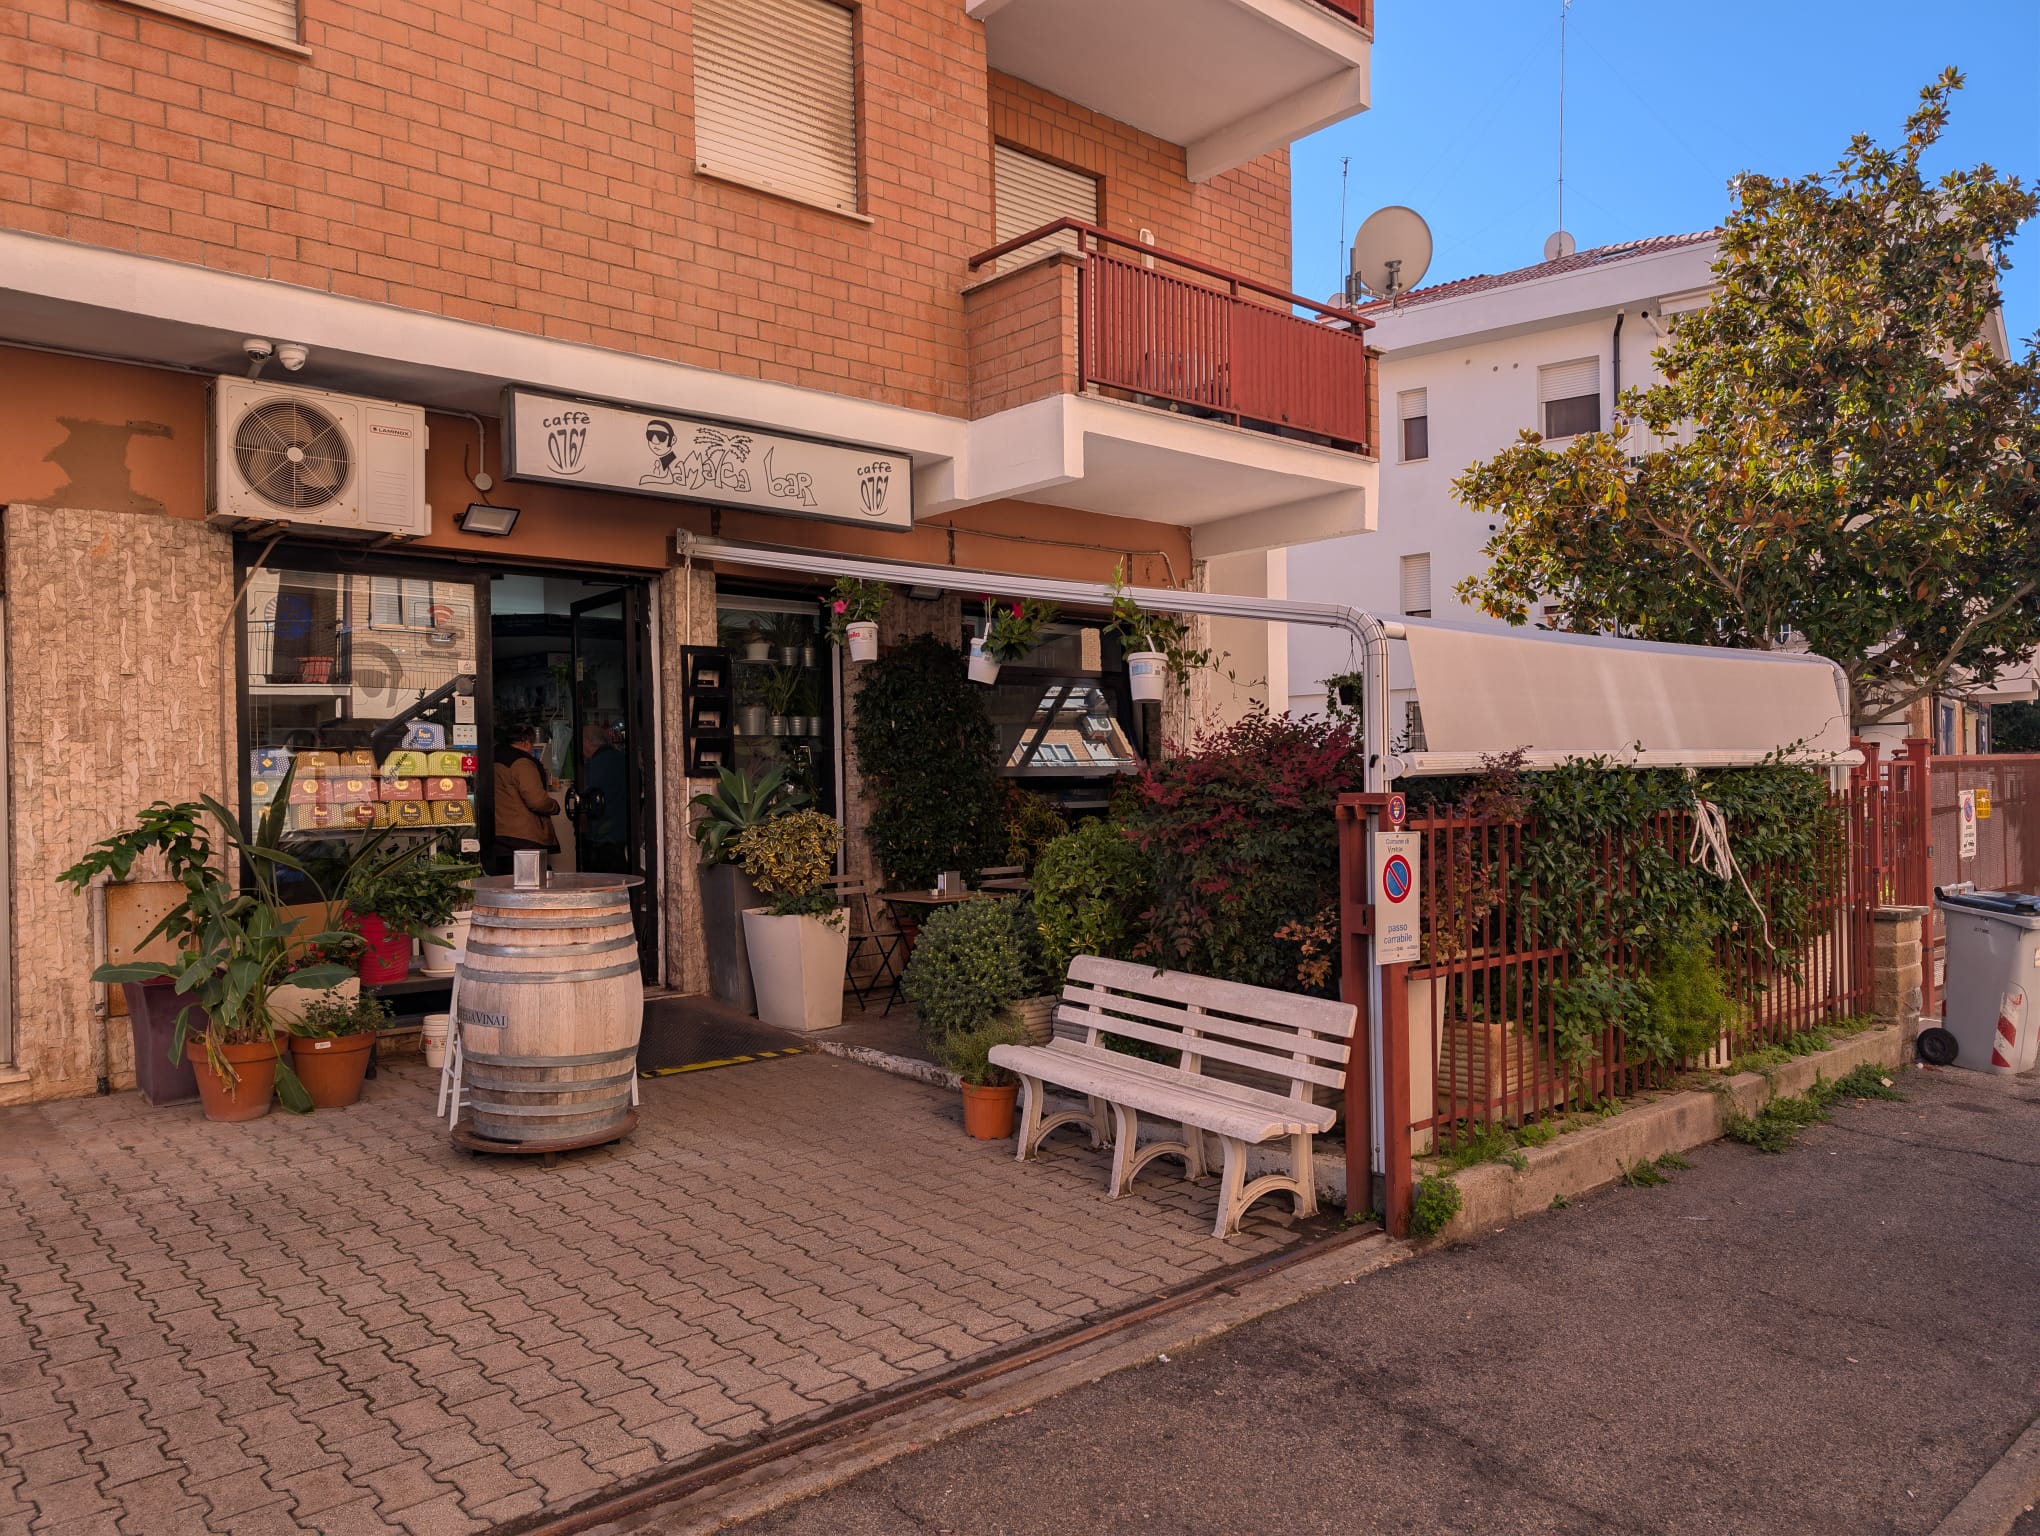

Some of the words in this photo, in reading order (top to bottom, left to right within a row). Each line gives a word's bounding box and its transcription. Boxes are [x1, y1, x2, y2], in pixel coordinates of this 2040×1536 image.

[543, 411, 591, 428] caffè
[548, 428, 587, 469] 0761
[857, 461, 892, 476] caffè
[860, 475, 889, 511] 0761
[1387, 924, 1408, 935] passo
[1384, 932, 1413, 945] carrabile
